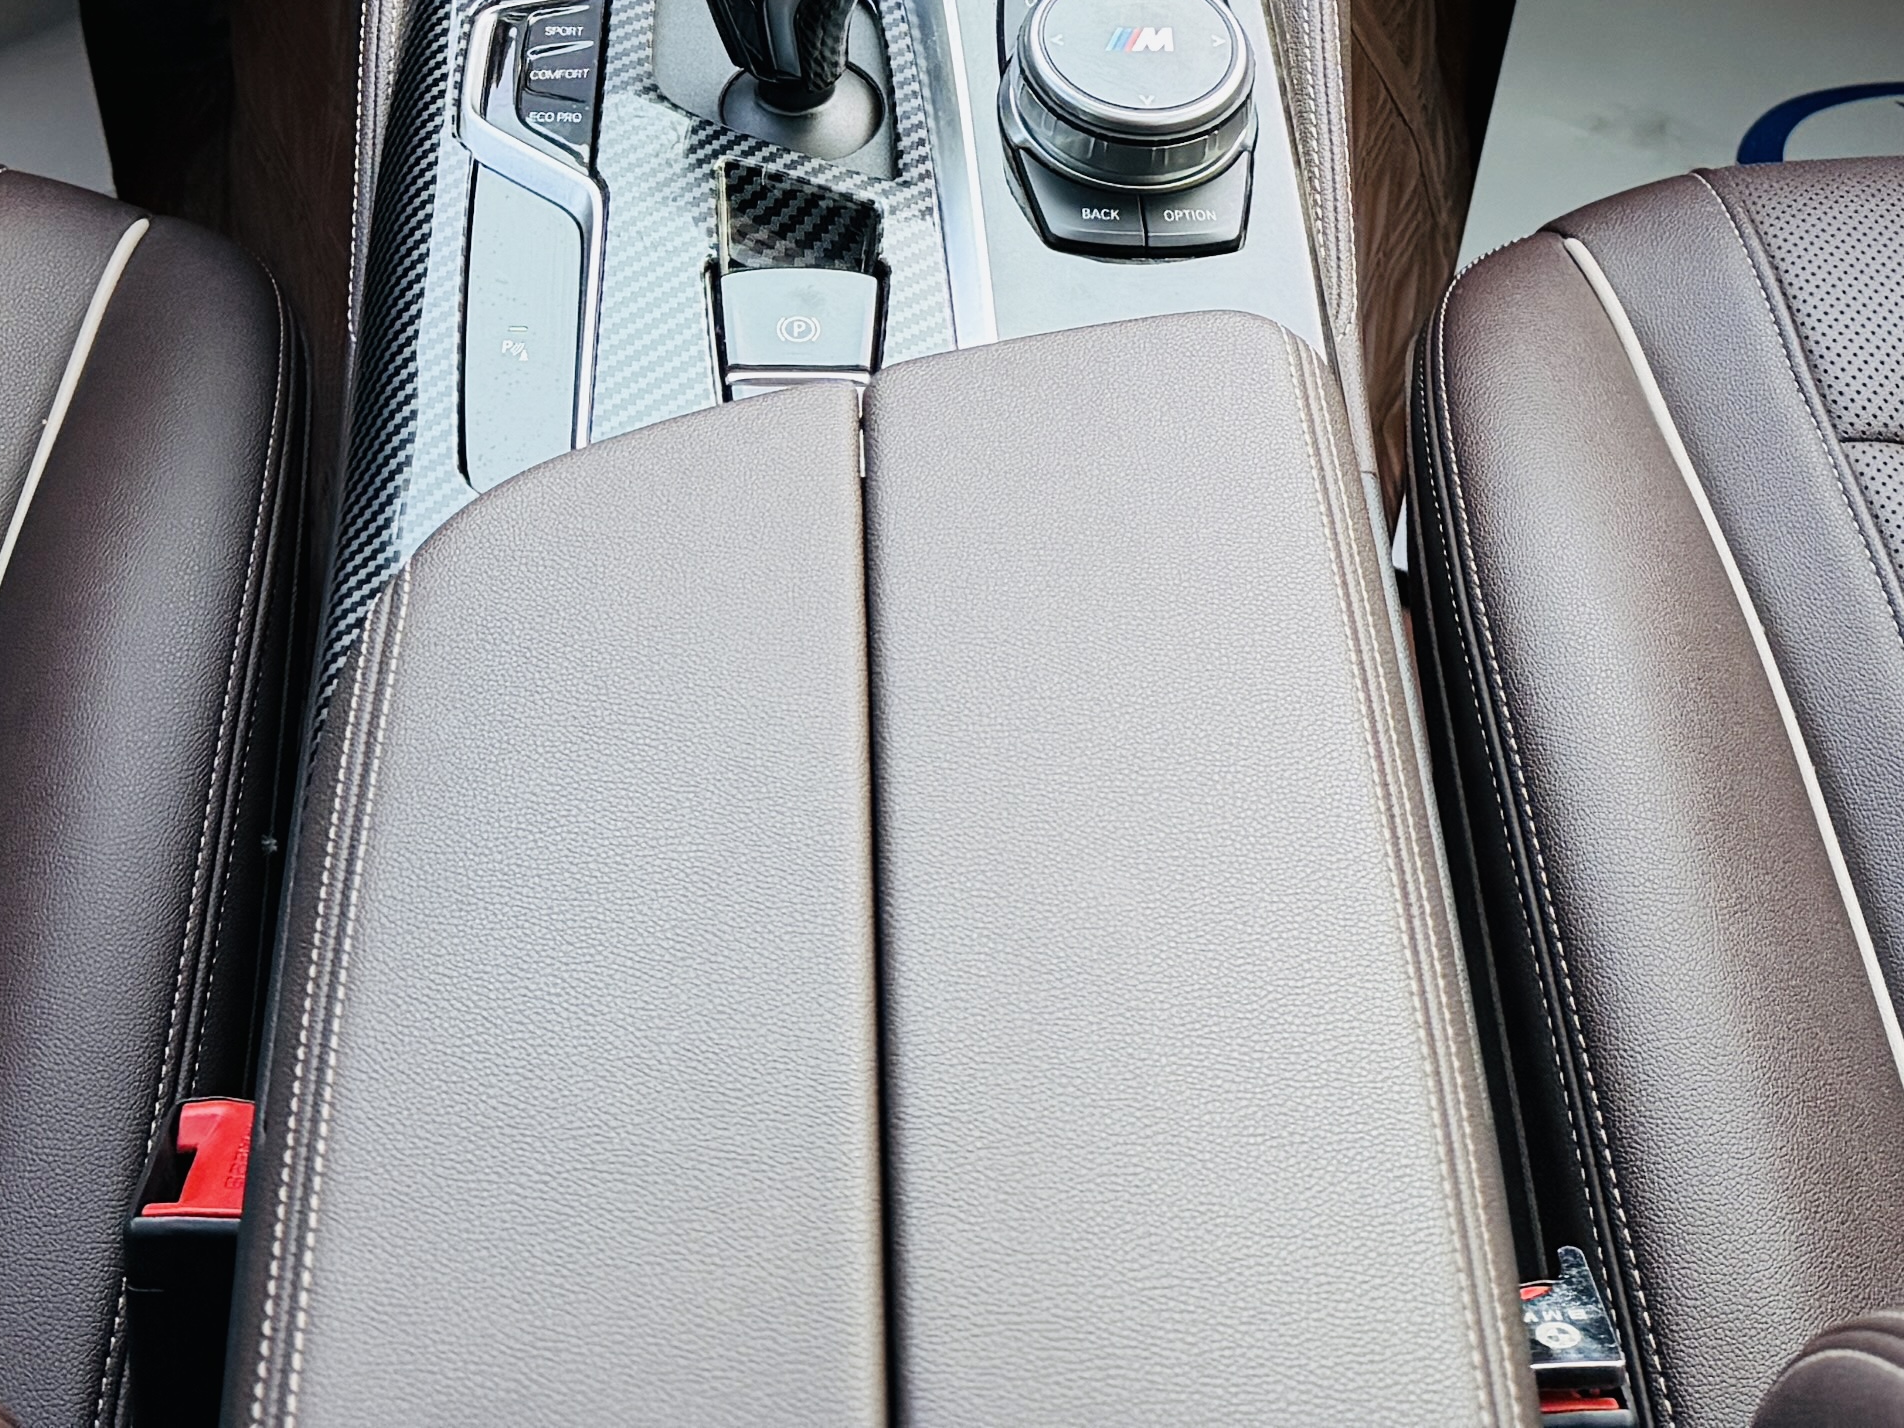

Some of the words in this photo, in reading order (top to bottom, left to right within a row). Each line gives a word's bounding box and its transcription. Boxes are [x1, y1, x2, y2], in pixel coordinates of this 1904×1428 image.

[544, 25, 585, 37] SPORT
[529, 68, 590, 81] COMFORT
[527, 111, 556, 124] ECO
[556, 111, 583, 123] PRO
[1081, 206, 1120, 223] BACK
[1163, 207, 1217, 223] OPTION
